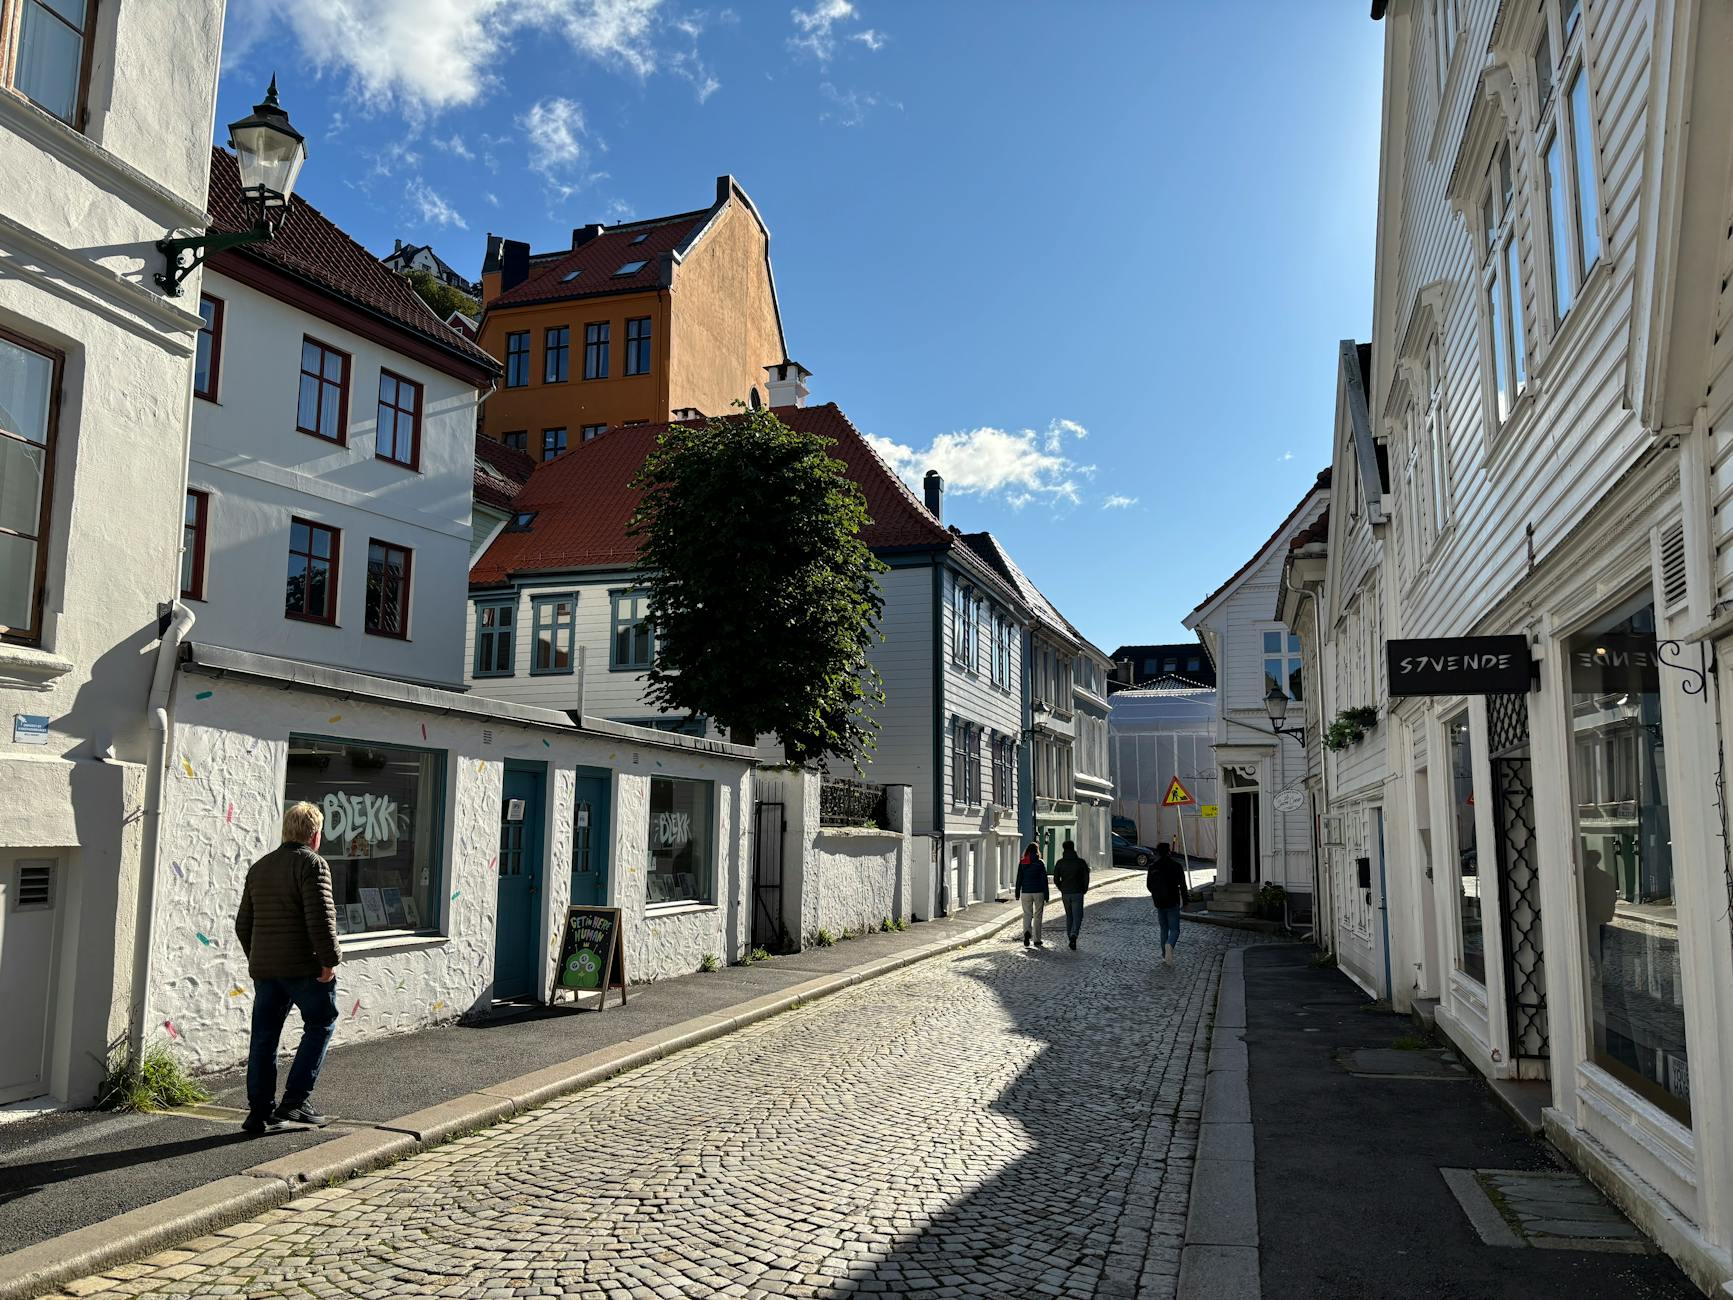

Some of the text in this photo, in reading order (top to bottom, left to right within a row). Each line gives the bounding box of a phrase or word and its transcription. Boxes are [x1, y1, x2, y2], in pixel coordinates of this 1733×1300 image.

[323, 791, 400, 842] BLEKK
[659, 811, 692, 844] BLEKK
[570, 915, 587, 929] GET
[592, 916, 613, 931] HERE
[574, 928, 605, 942] HUMAN
